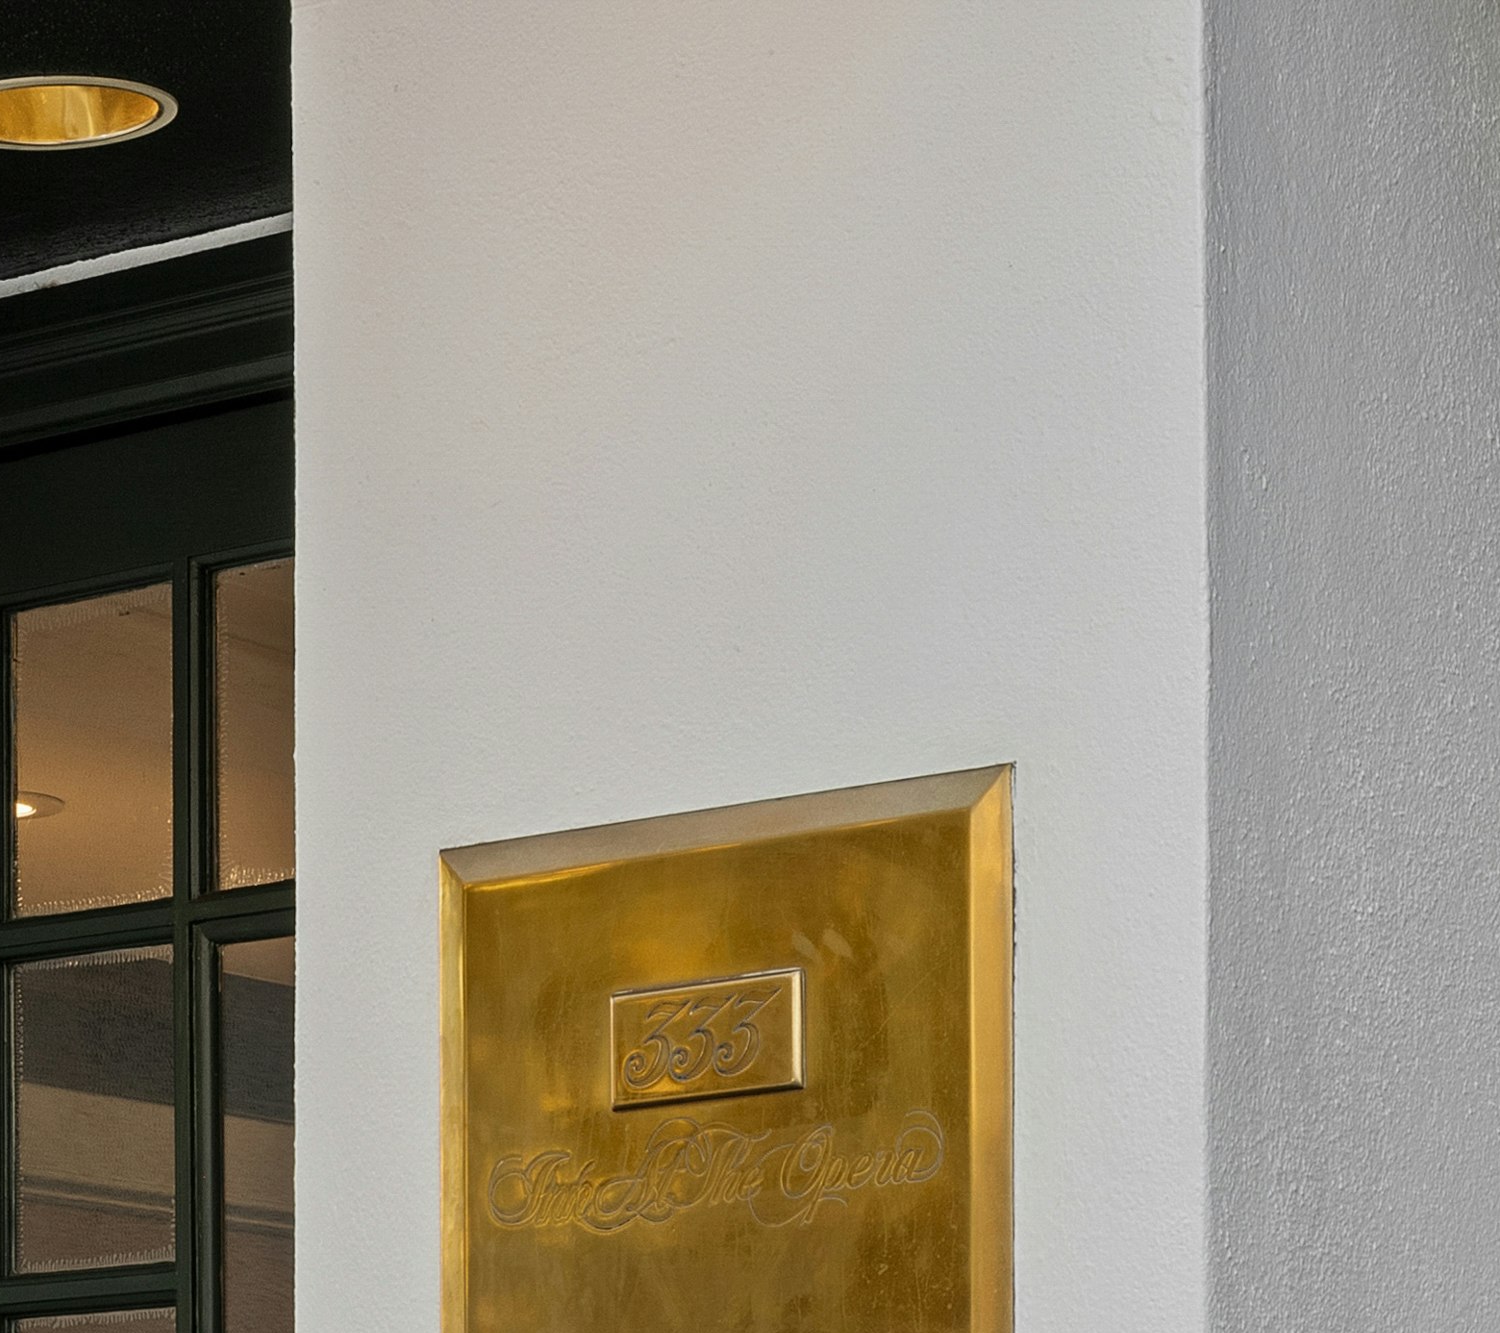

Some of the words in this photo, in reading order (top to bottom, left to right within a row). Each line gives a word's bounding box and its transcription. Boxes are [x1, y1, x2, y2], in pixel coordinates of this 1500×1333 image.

[622, 985, 783, 1091] 333
[488, 1149, 596, 1231] Inn
[582, 1117, 698, 1234] At
[686, 1121, 773, 1208] The
[749, 1109, 945, 1228] Opera
